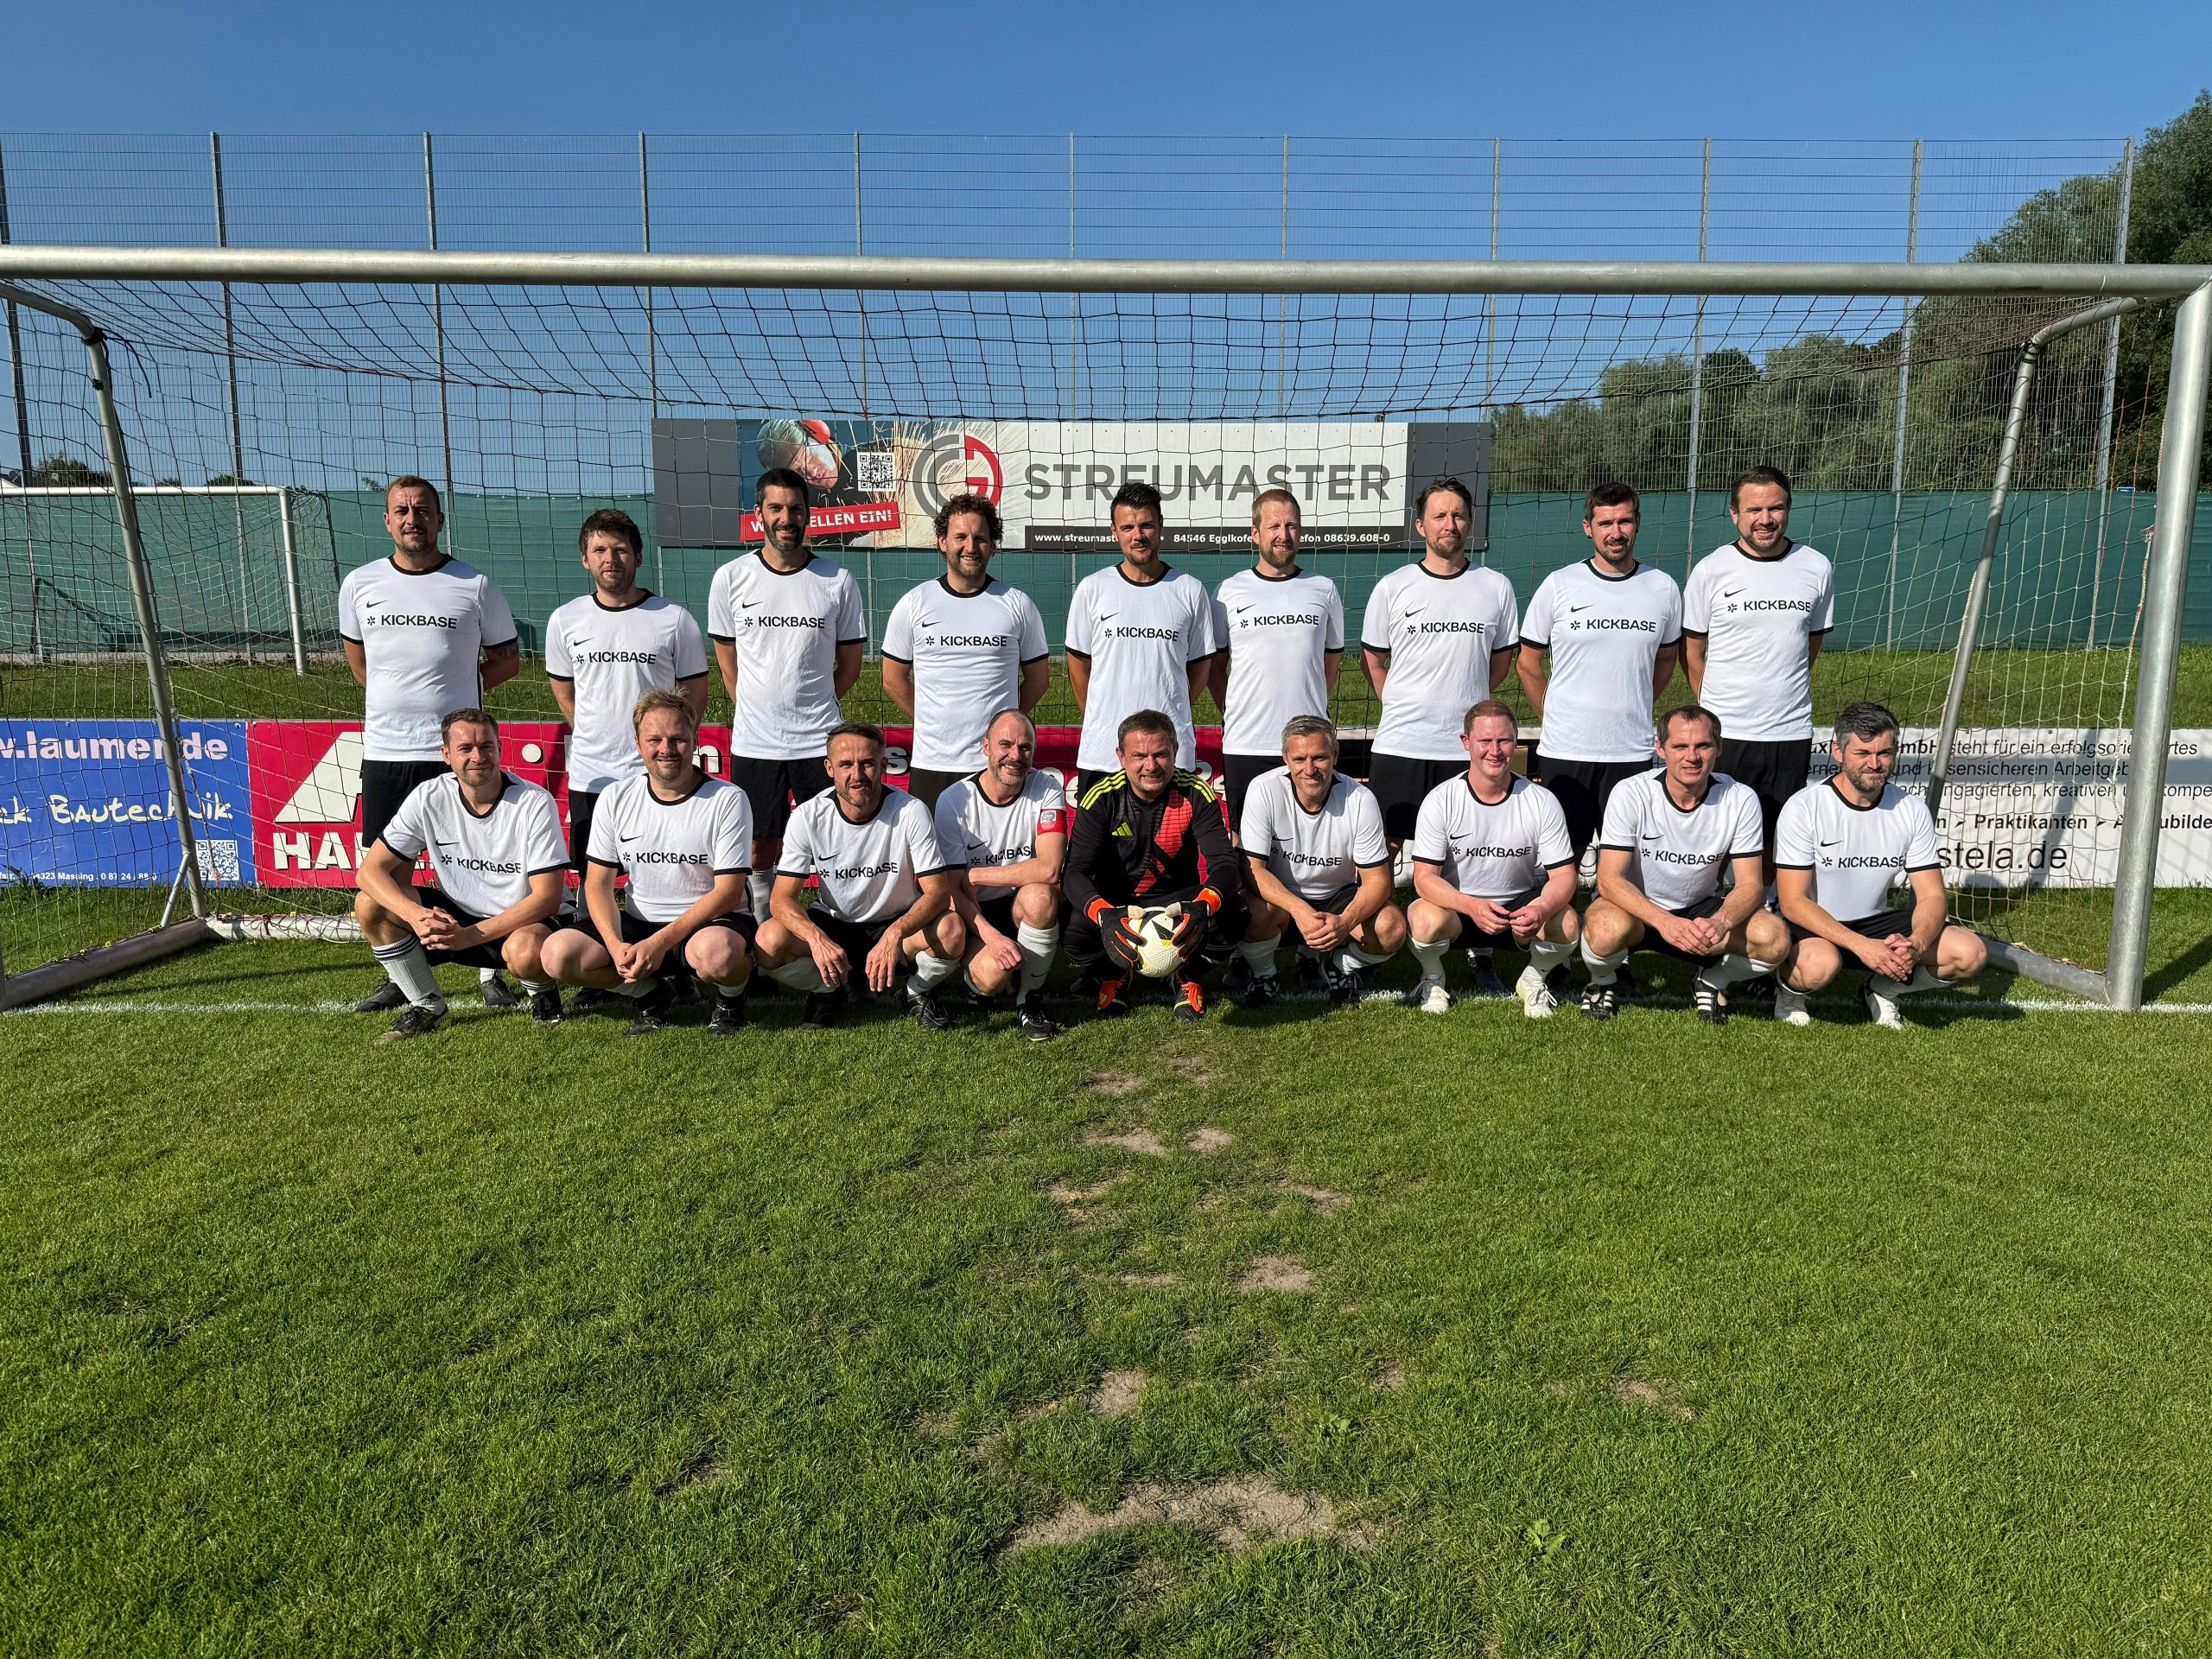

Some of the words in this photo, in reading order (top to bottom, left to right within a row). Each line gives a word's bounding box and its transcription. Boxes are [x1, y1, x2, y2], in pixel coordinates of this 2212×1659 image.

[1024, 464, 1390, 501] STREUMASTER
[810, 512, 855, 528] ELLEN
[859, 509, 893, 524] EIN!
[1034, 534, 1116, 543] www.streumast
[1173, 534, 1206, 543] 84546
[1209, 534, 1253, 544] Egglkofe
[1300, 533, 1321, 543] efon
[1324, 533, 1390, 543] 08639.608-0
[1744, 600, 1812, 613] KICKBASE
[381, 614, 457, 629] KICKBASE
[758, 615, 825, 629] KICKBASE
[1254, 614, 1319, 626] KICKBASE
[1586, 619, 1656, 632] KICKBASE
[1116, 626, 1179, 642] KICKBASE
[1421, 621, 1484, 634] KICKBASE
[940, 635, 1008, 648] KICKBASE
[588, 652, 657, 665] KICKBASE
[0, 730, 227, 760] .laumerde
[1950, 741, 1987, 754] steht
[1993, 740, 2015, 754] für
[2020, 741, 2044, 754] ein
[2054, 760, 2129, 779] Arbeitgeb
[1944, 782, 2036, 799] ngagierten,
[2044, 783, 2116, 797] kreativen
[1974, 814, 2088, 830] Praktikanten
[636, 852, 709, 865] KICKBASE
[1282, 850, 1343, 868] KICKBASE
[1466, 846, 1532, 859] KICKBASE
[1655, 850, 1724, 865] KICKBASE
[456, 857, 522, 874] KICKBASE
[1838, 855, 1904, 868] KICKBASE
[58, 872, 94, 882] Massing
[121, 872, 131, 880] 24
[835, 861, 898, 880] KICKBASE
